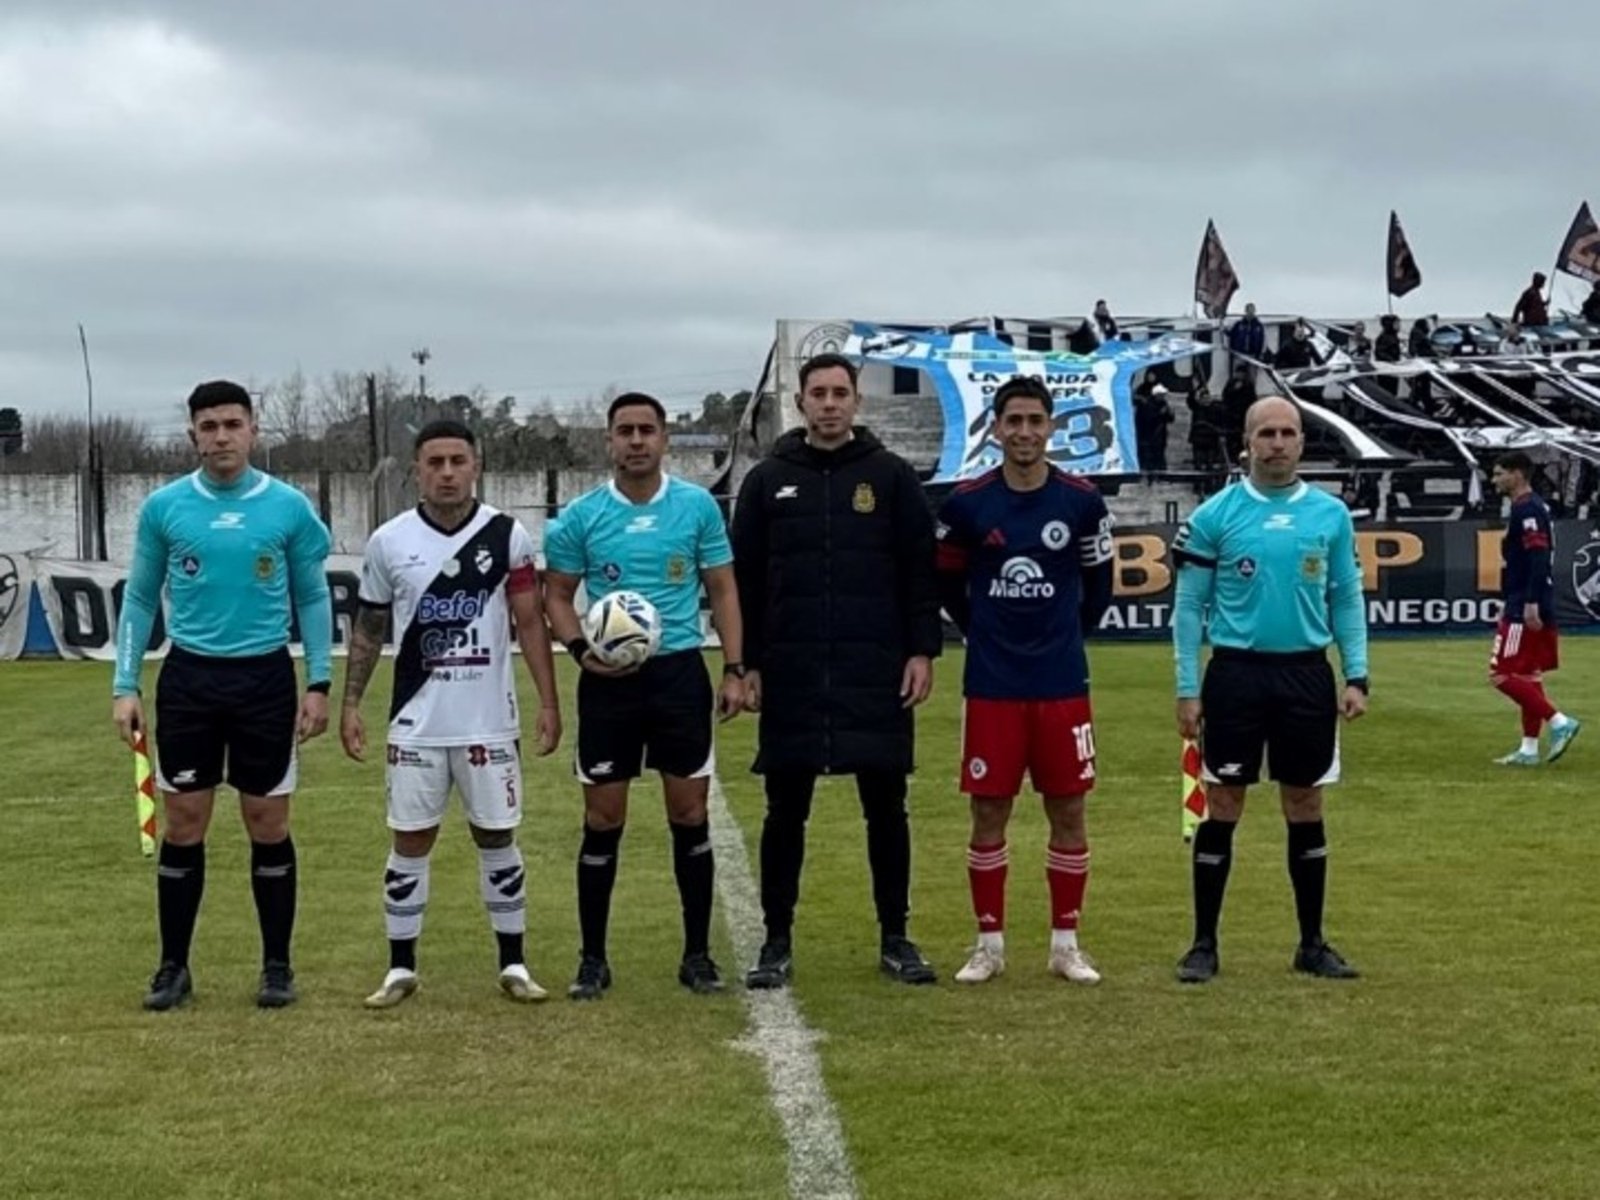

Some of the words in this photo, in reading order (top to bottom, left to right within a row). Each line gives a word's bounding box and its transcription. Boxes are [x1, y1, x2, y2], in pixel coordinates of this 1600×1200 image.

[967, 373, 1000, 382] LA
[1050, 386, 1092, 397] EPE
[988, 578, 1055, 598] Macro
[418, 590, 488, 622] Befol
[1098, 603, 1176, 630] ALT
[1368, 599, 1505, 623] NEGOC
[1071, 722, 1095, 762] 10
[506, 779, 516, 808] 5
